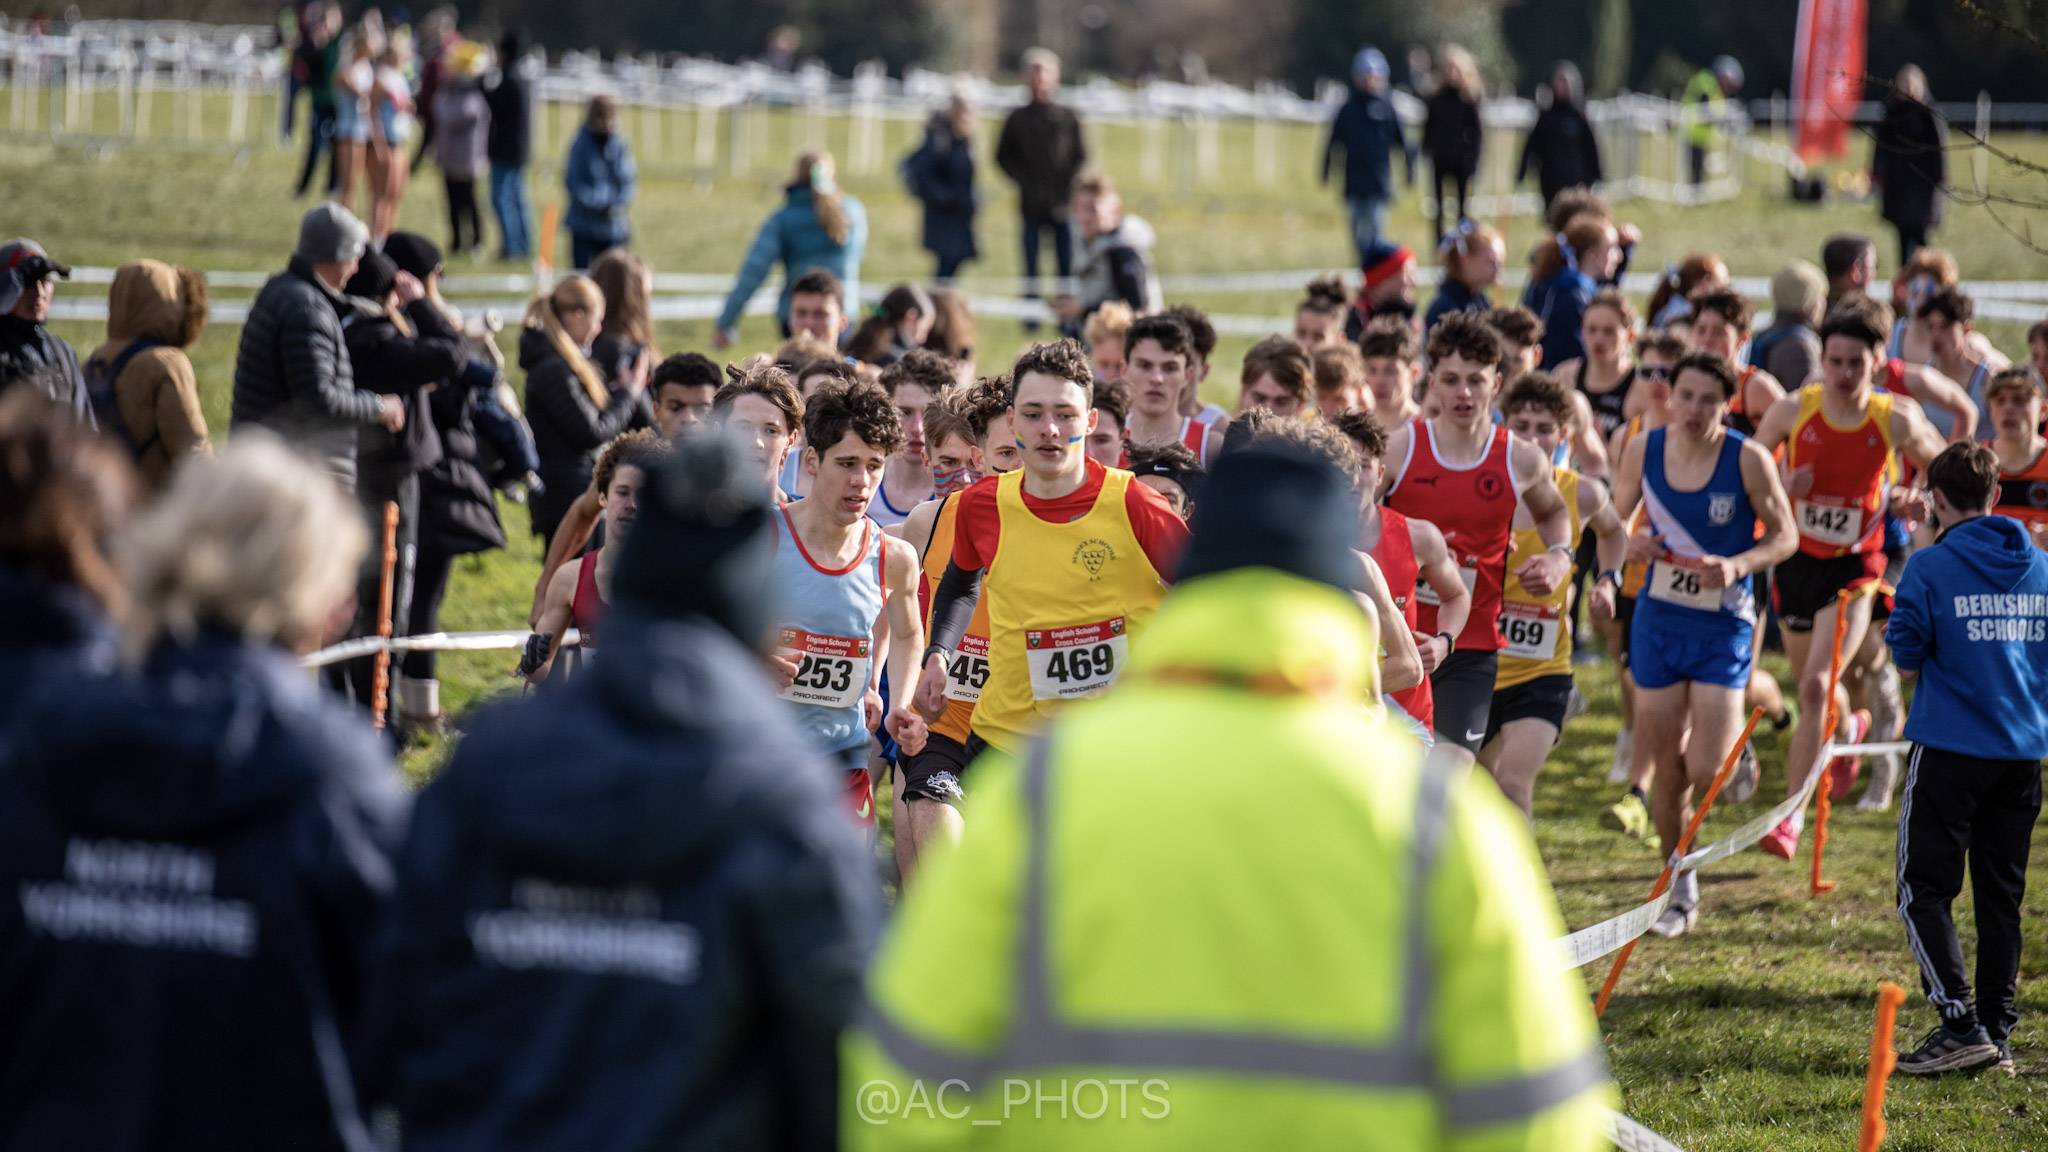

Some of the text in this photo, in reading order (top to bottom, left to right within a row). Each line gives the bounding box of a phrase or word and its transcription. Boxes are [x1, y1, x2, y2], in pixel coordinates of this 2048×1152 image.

[1805, 506, 1849, 534] 542
[1089, 538, 1116, 561] SCHOOLS
[1670, 568, 1700, 595] 26
[1954, 593, 2048, 618] BERKSHIR
[806, 635, 851, 648] English Schools
[963, 635, 985, 647] English
[1051, 625, 1100, 640] English Schools
[1055, 635, 1099, 648] Cross Country
[1967, 618, 2046, 642] SCHOOLS
[807, 644, 847, 657] Cross Country
[964, 644, 981, 655] Cross
[793, 654, 854, 692] 253
[1046, 643, 1114, 683] 469
